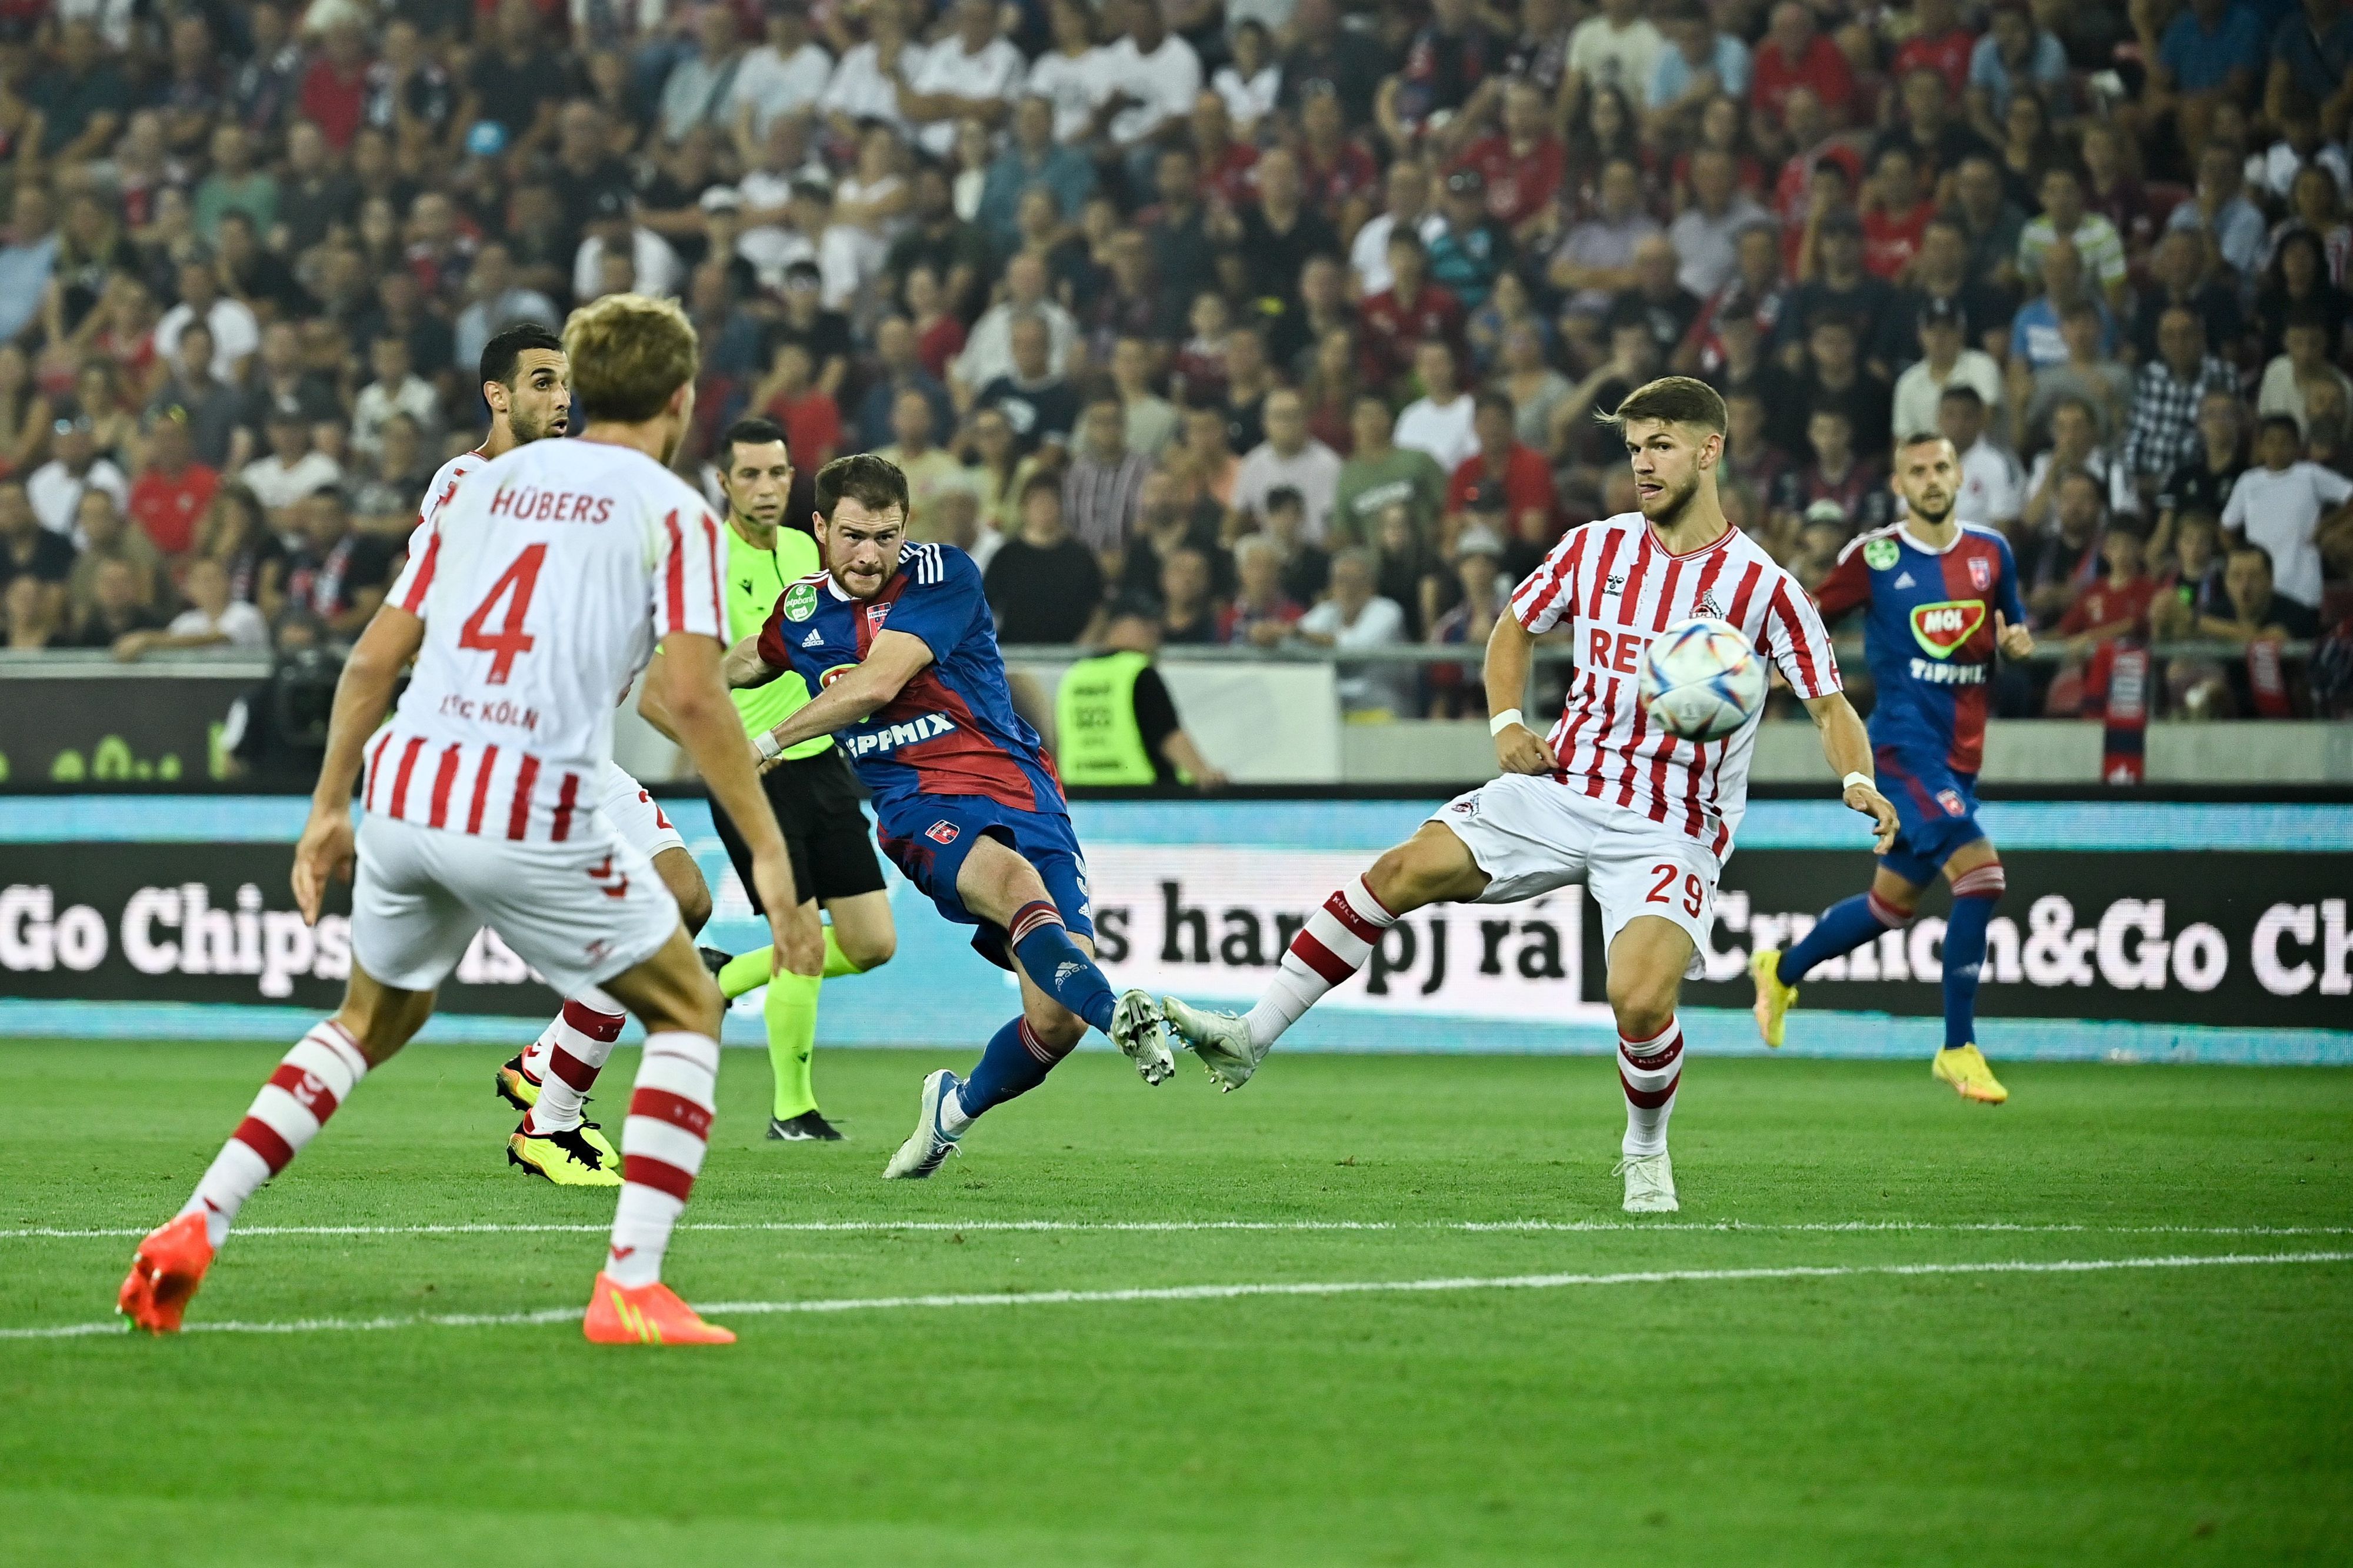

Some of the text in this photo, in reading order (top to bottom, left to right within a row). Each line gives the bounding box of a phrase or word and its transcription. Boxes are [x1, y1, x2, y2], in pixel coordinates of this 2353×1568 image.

[489, 485, 615, 524] HÜBERS
[458, 542, 549, 685] 4
[1924, 609, 1964, 634] MOL
[802, 639, 824, 648] adidas
[1590, 628, 1653, 675] RE
[1332, 896, 1359, 924] KÖLN
[1645, 863, 1704, 919] 29
[0, 883, 108, 972] Go
[121, 882, 352, 997] Chips
[1159, 880, 1447, 995] harpj
